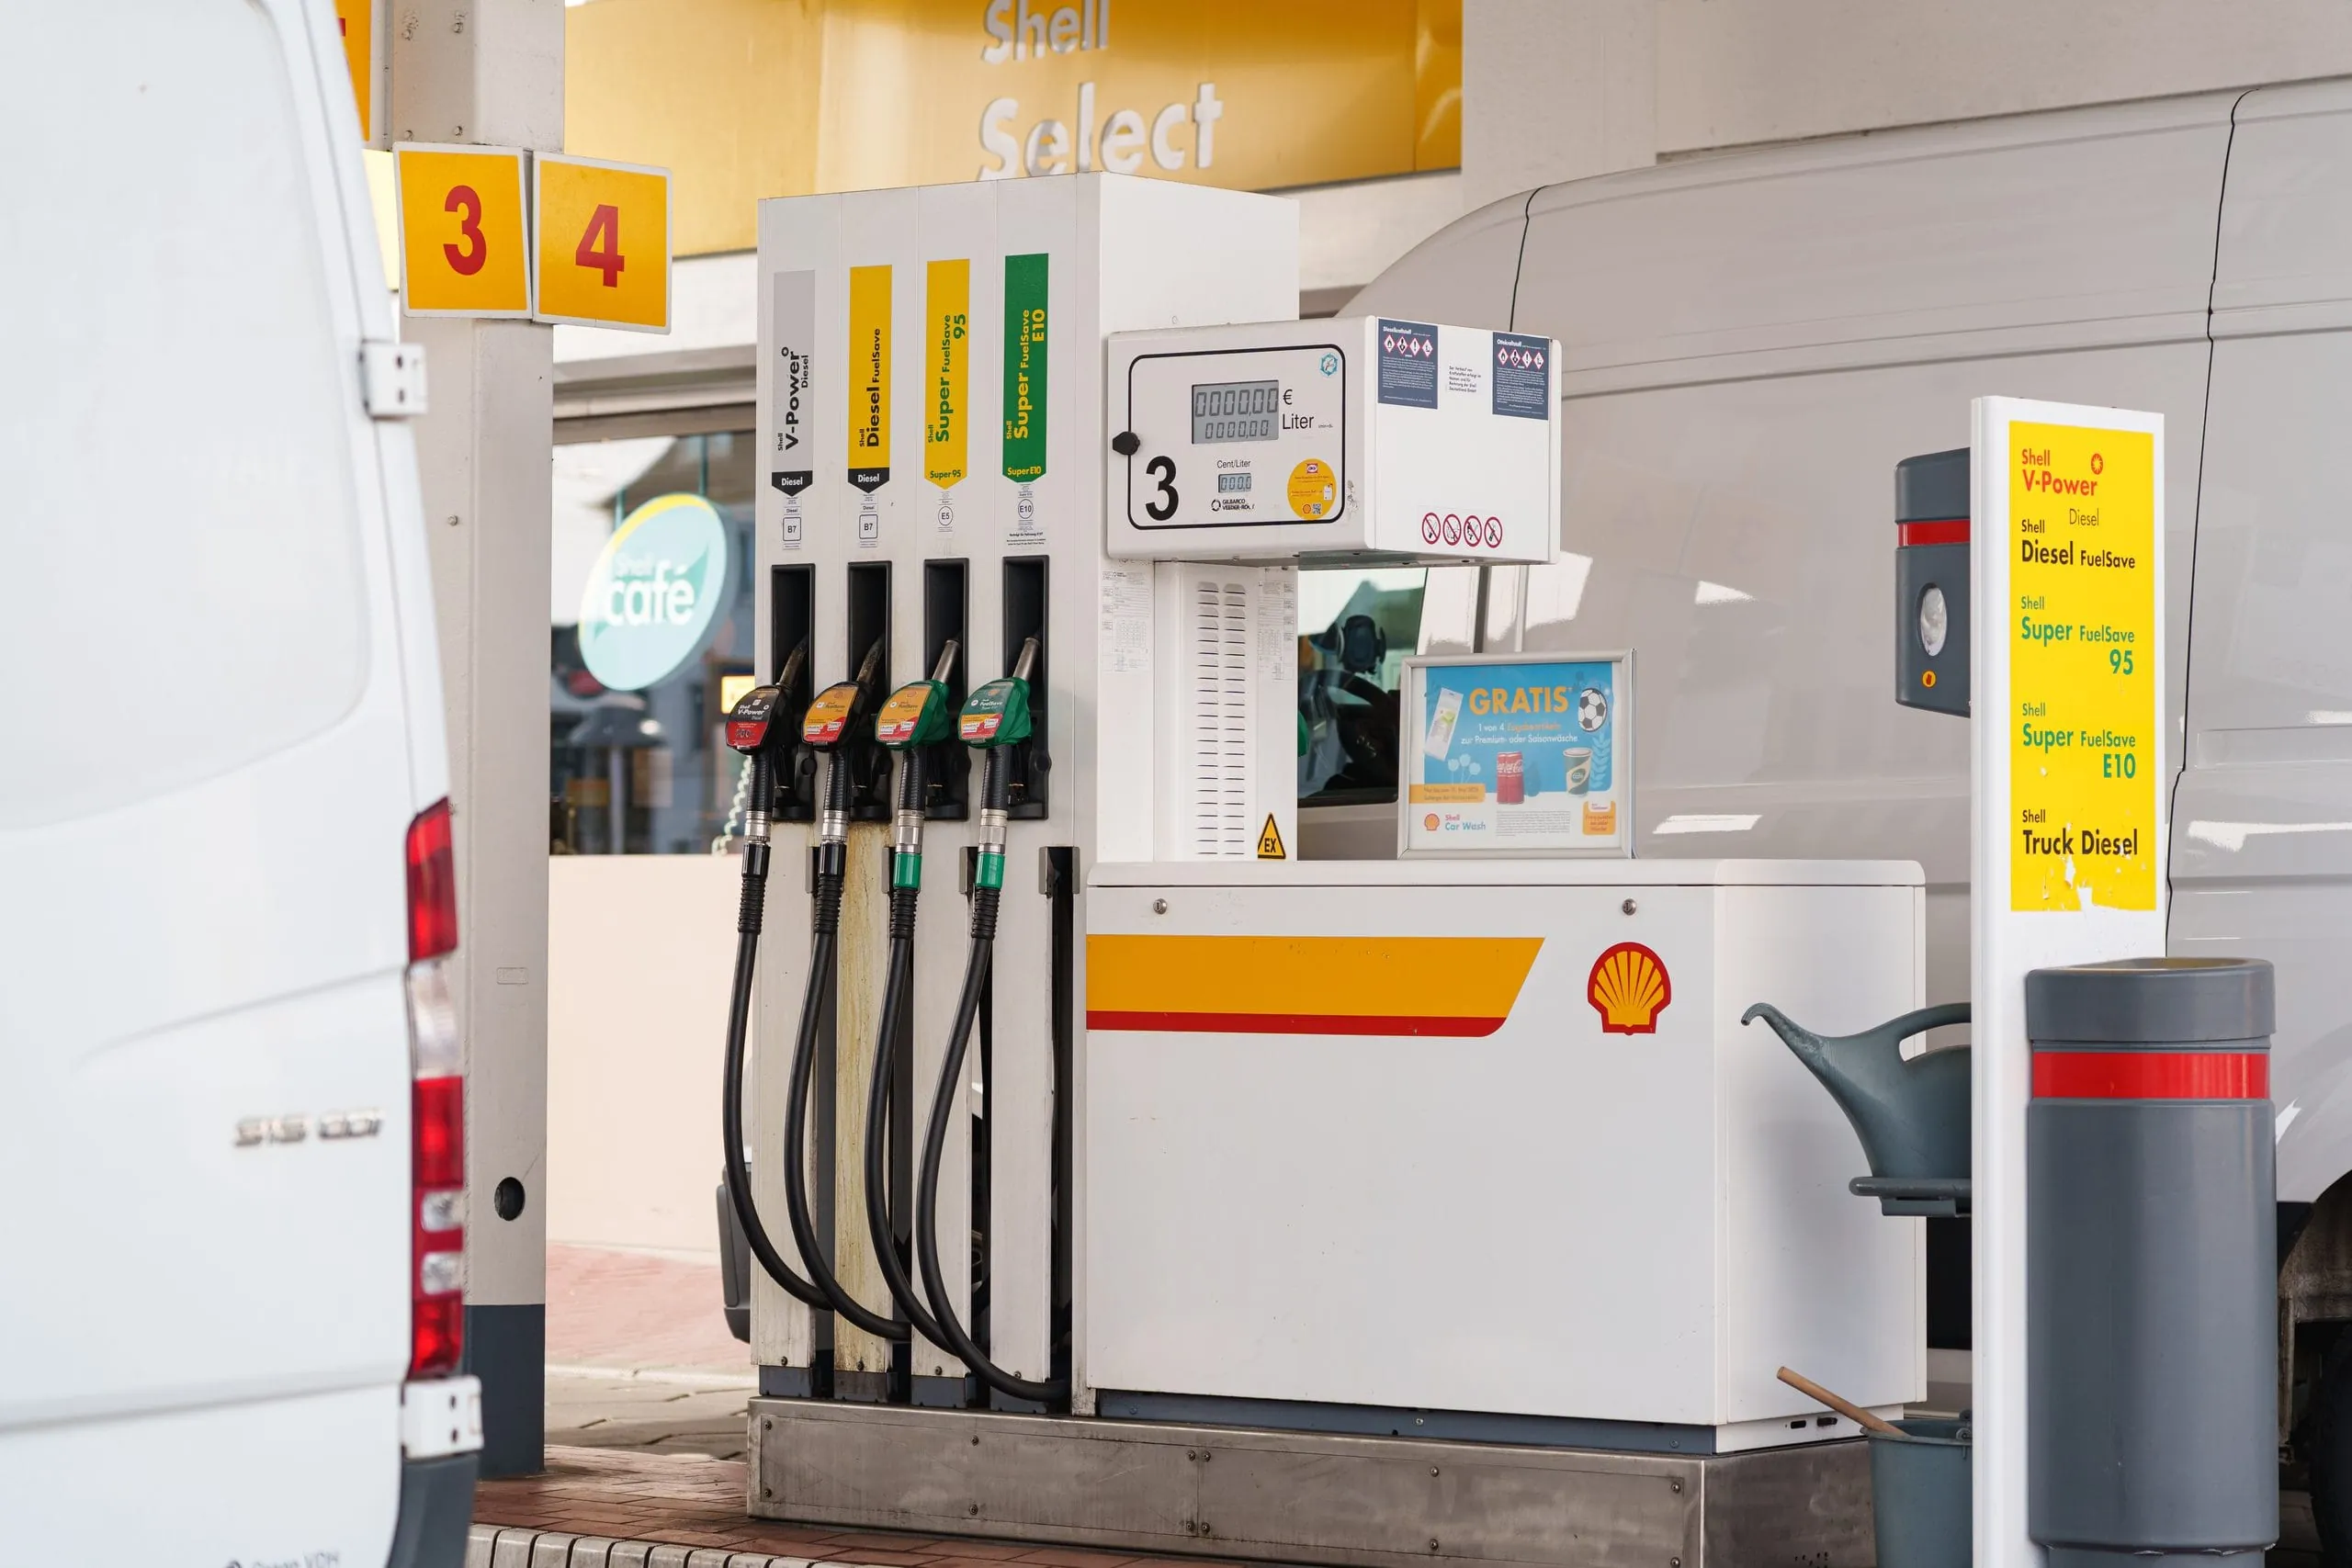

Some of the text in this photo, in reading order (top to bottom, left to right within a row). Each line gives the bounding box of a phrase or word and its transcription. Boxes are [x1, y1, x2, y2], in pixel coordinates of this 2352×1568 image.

[980, 0, 1110, 64] Shell
[977, 82, 1224, 180] Select
[443, 185, 486, 276] 3
[575, 205, 625, 288] 4
[954, 314, 966, 339] 95
[1032, 309, 1045, 341] E10
[935, 314, 954, 442] Super FuelSave
[1014, 310, 1033, 439] Super FuelSave
[866, 329, 880, 446] Diesel FuelSave
[1283, 389, 1293, 405] €
[786, 351, 799, 450] V-Power
[1282, 413, 1315, 430] Liter
[1216, 459, 1251, 468] Cent/Liter
[2021, 447, 2051, 467] Shell
[781, 477, 803, 486] Diesel
[858, 473, 879, 482] Diesel
[930, 469, 961, 480] Super 95
[1008, 467, 1041, 477] Super E10
[2022, 468, 2098, 496] V-Power
[1145, 456, 1180, 522] 3
[1019, 505, 1032, 513] E10
[2069, 507, 2099, 526] Diesel
[864, 523, 873, 531] B7
[2021, 519, 2045, 534] Shell
[2022, 539, 2135, 569] Diesel FuelSave
[605, 559, 695, 626] café
[2021, 595, 2045, 610] Shell
[2021, 615, 2135, 648] Super FuelSave
[2109, 649, 2133, 675] 95
[2022, 702, 2046, 716] Shell
[1510, 735, 1526, 743] oder
[2023, 723, 2136, 753] Super FuelSave
[2103, 753, 2136, 779] E10
[1445, 821, 1486, 830] Car Wash
[2022, 809, 2046, 823] Shell
[1264, 838, 1276, 852] EX
[2023, 828, 2138, 855] Truck Diesel
